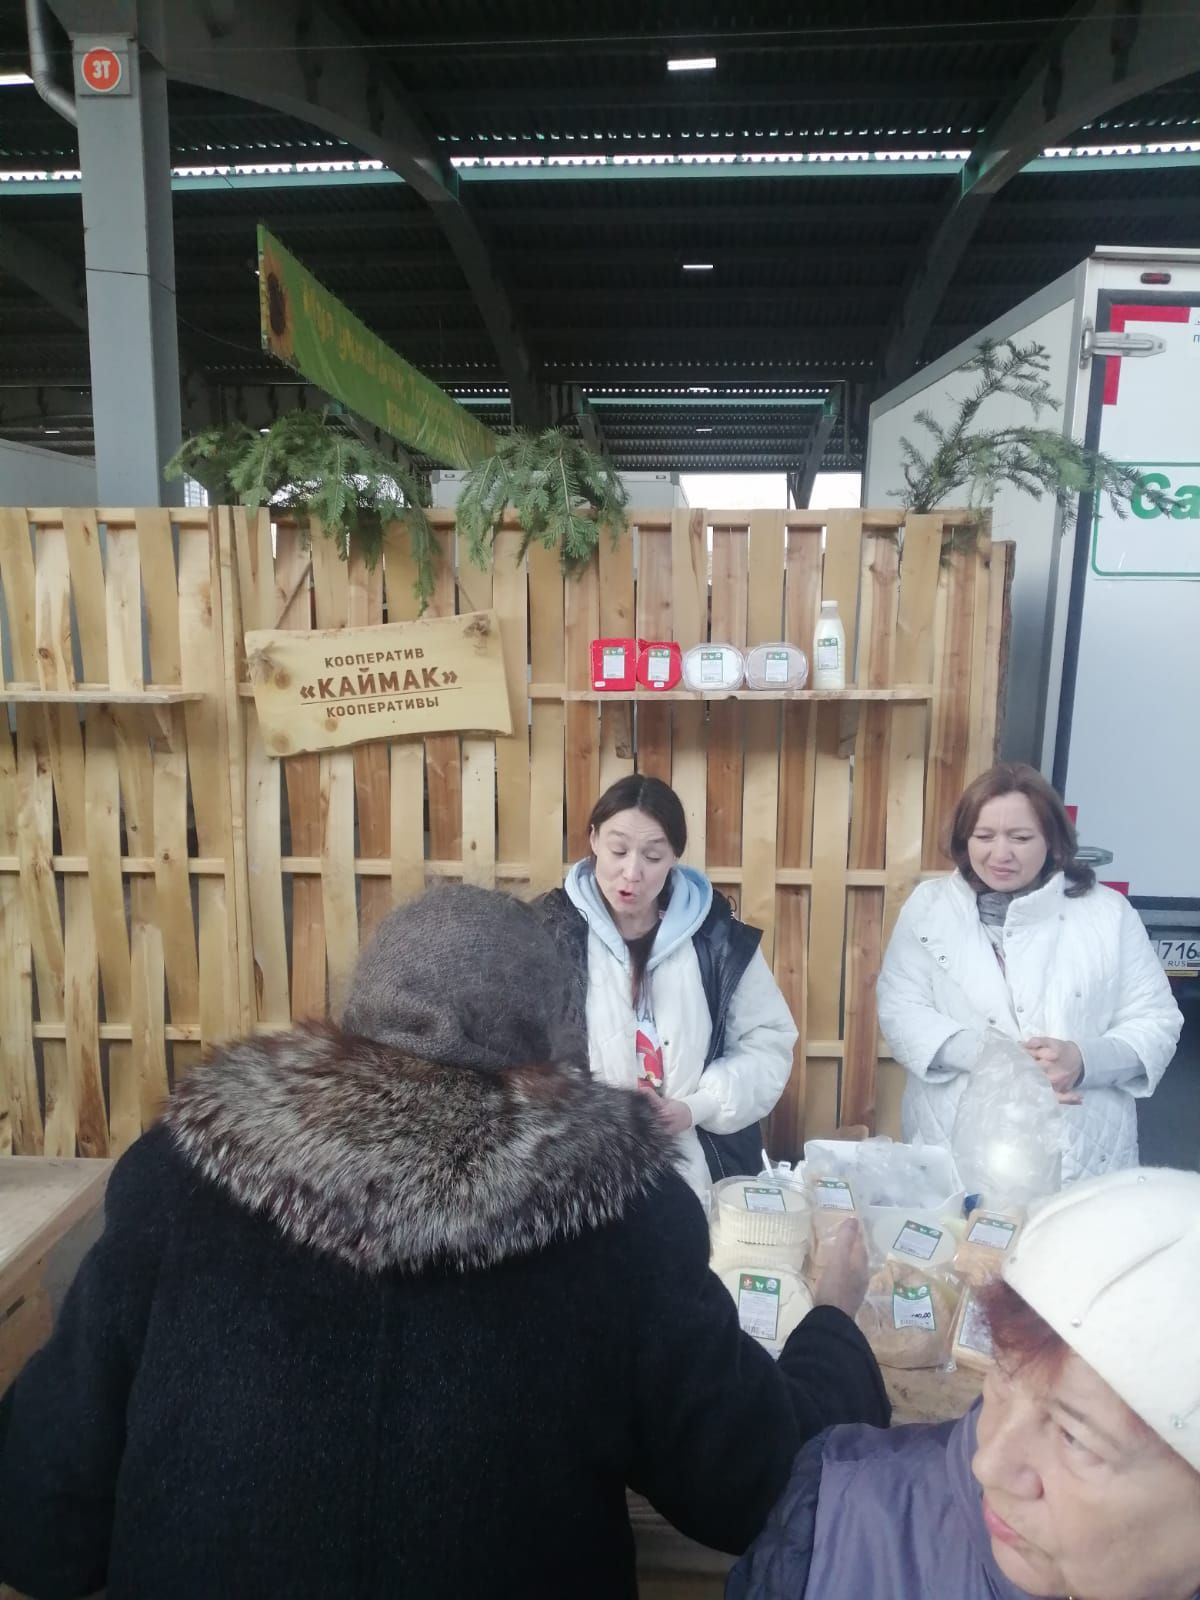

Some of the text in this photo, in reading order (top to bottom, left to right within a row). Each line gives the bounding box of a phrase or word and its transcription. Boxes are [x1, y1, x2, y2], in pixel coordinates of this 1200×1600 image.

[324, 647, 424, 669] КООПЕРАТИВ
[299, 666, 458, 700] «КАЙМАК»
[326, 696, 439, 718] КООПЕРАТИВЫ
[1162, 942, 1198, 960] 716
